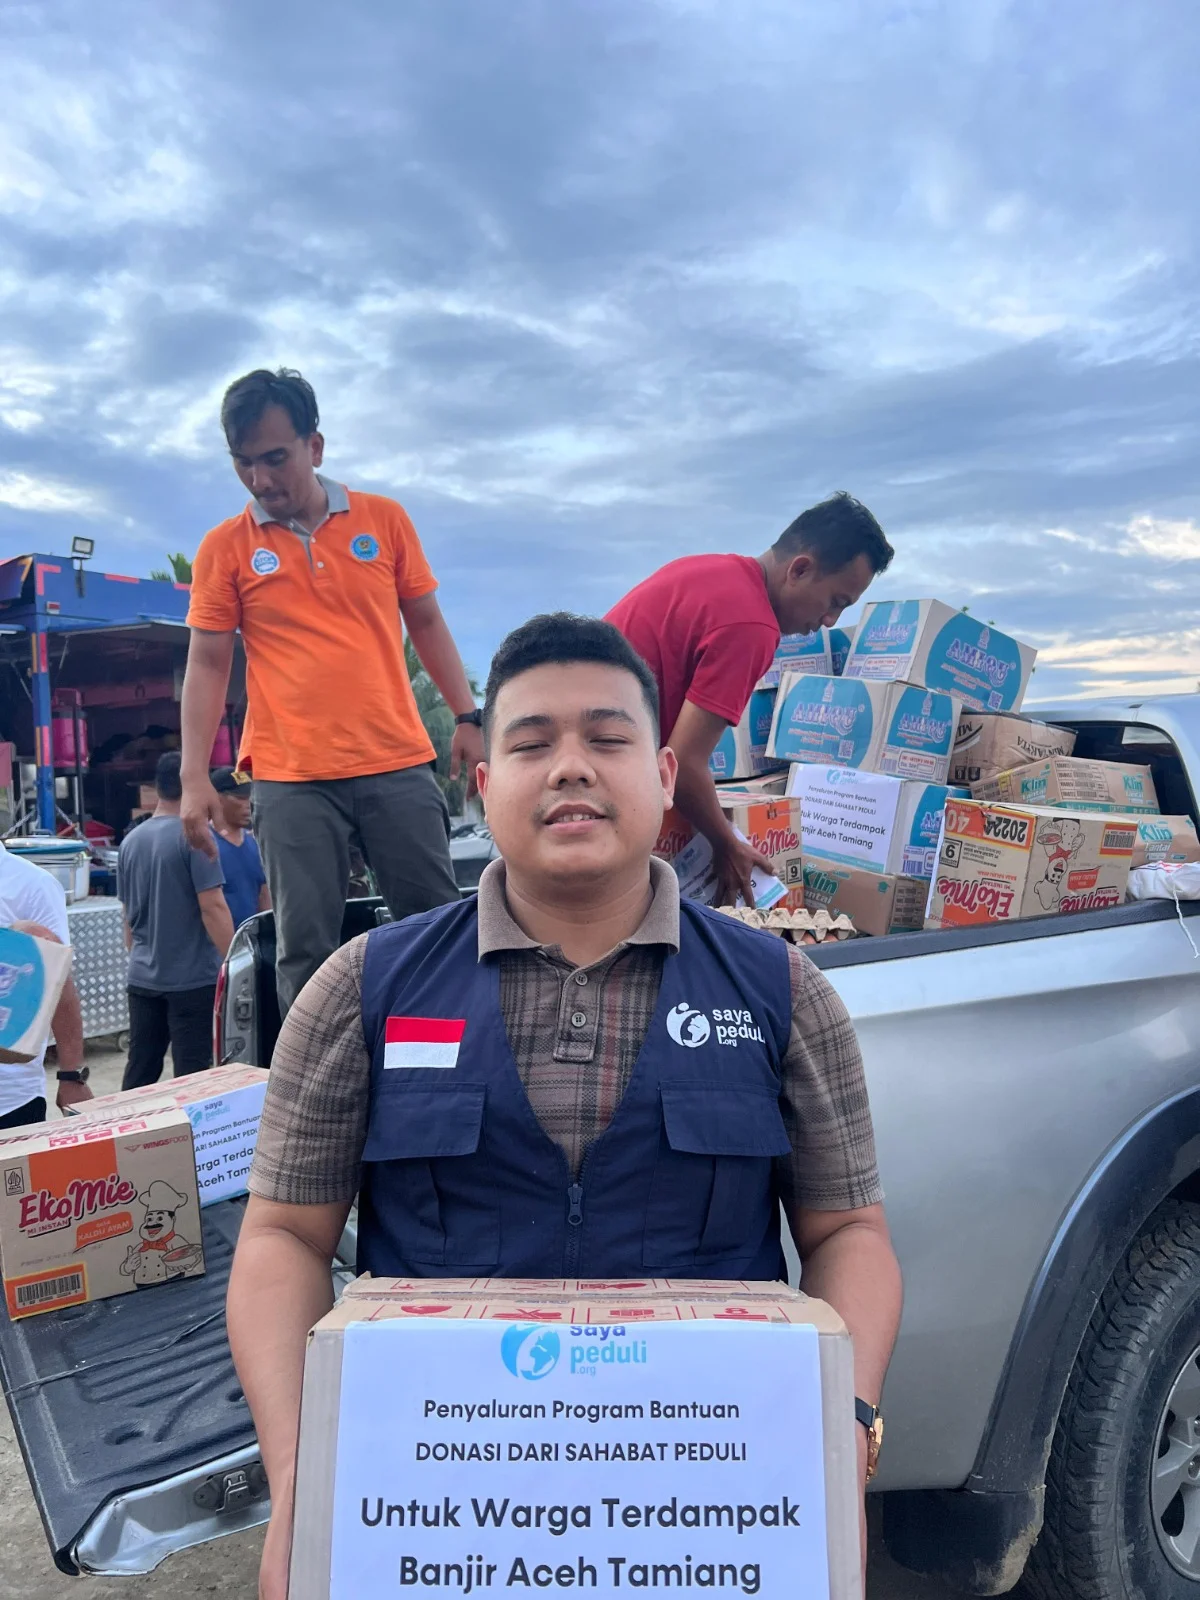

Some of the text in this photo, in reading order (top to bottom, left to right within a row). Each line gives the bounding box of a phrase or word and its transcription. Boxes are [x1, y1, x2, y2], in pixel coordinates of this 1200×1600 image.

[946, 638, 1010, 687] AMIQU
[1021, 778, 1047, 794] Klin
[833, 790, 854, 799] Program
[855, 793, 877, 803] Bantuan
[835, 801, 858, 811] SAHABAT
[858, 805, 876, 815] PEDULI
[813, 812, 838, 825] Warga
[840, 818, 886, 836] Terdampak
[946, 810, 970, 833] 40
[748, 827, 799, 855] koMie
[801, 825, 873, 849] anjir Aceh Tamiang
[1139, 824, 1172, 841] Klin
[945, 844, 955, 859] 9
[790, 866, 798, 878] 9
[939, 878, 1014, 918] EkoMie
[712, 1009, 753, 1025] saya
[204, 1101, 223, 1111] saya
[202, 1123, 232, 1137] Program
[208, 1133, 240, 1148] SAHABAT
[196, 1159, 220, 1172] arga
[222, 1147, 256, 1163] Terda
[18, 1175, 136, 1229] EkoMie
[39, 1220, 68, 1232] INSTAN
[79, 1221, 129, 1240] KALDU AYAM
[570, 1340, 647, 1374] peduli
[576, 1366, 596, 1376] .org
[424, 1399, 740, 1423] Penyaluran Program Bantuan
[416, 1442, 746, 1461] DONASI DARI SAHABAT PEDULI
[361, 1496, 800, 1536] Untuk Warga Terdampak
[400, 1555, 761, 1594] Banjir Aceh Tamiang
